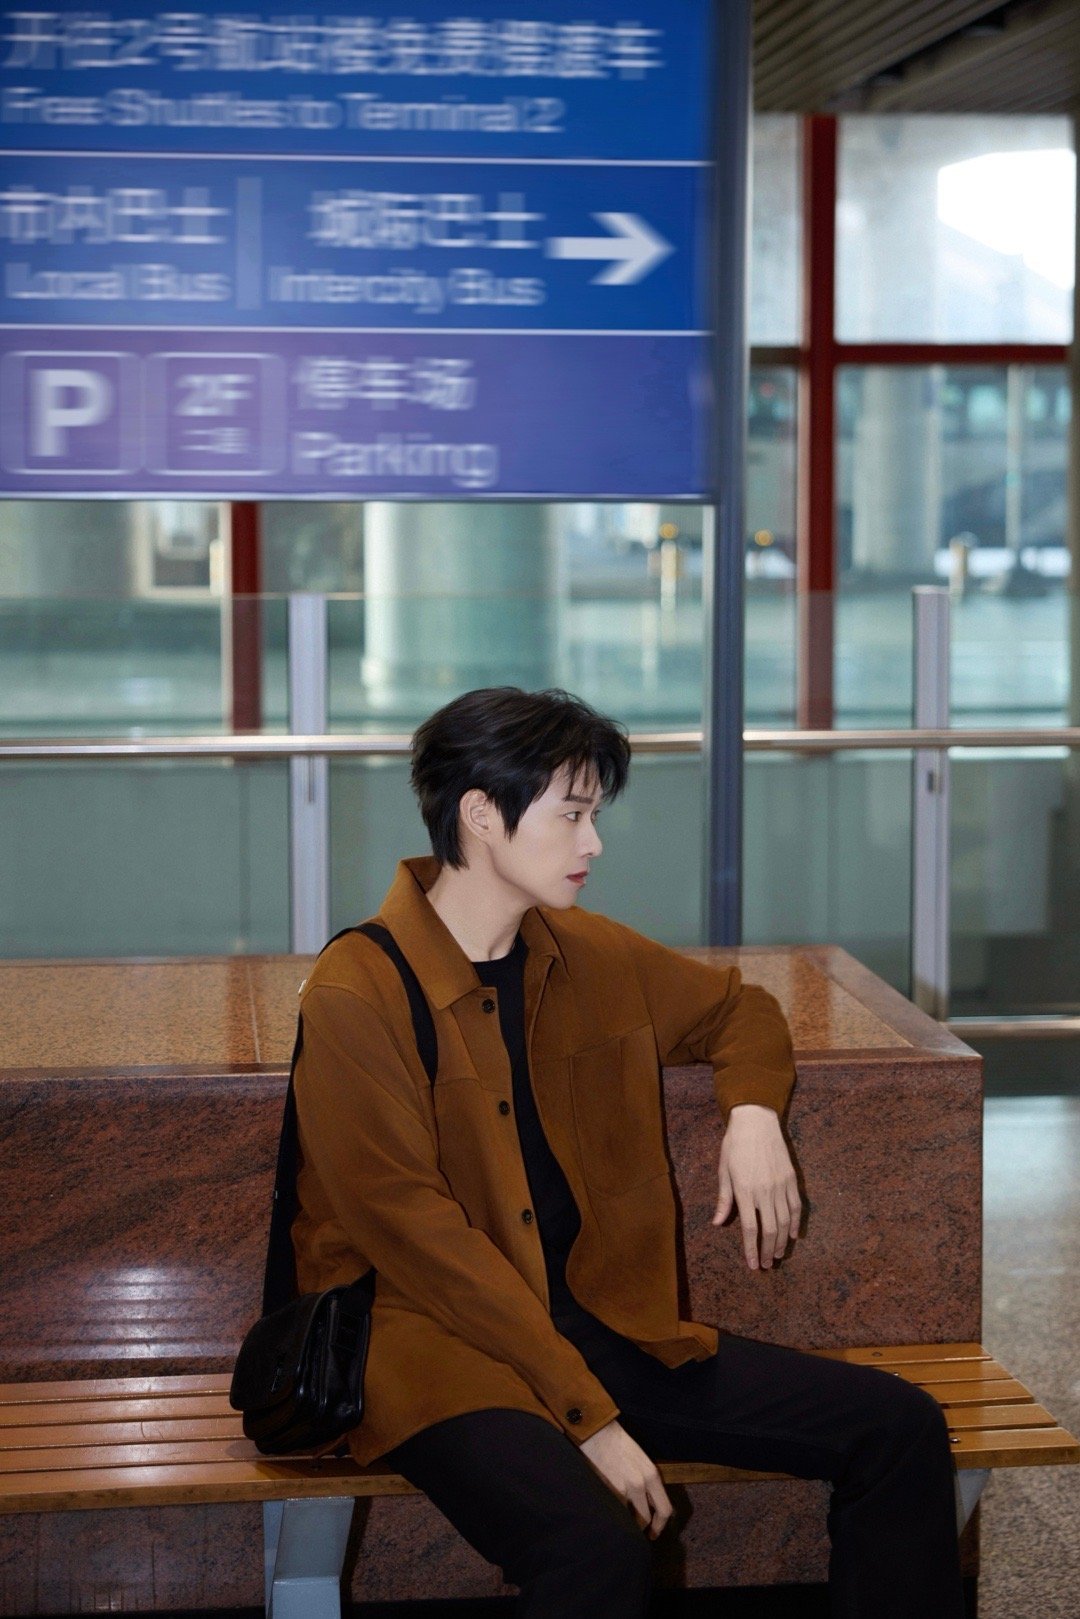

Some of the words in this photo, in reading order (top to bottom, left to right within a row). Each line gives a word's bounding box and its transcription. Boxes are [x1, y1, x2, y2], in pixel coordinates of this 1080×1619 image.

[339, 92, 522, 132] Terminal
[524, 96, 564, 133] 2
[8, 262, 130, 300] Local
[134, 263, 228, 301] Bus
[448, 268, 545, 305] Bus
[30, 368, 113, 457] P
[294, 431, 497, 488] Parking
